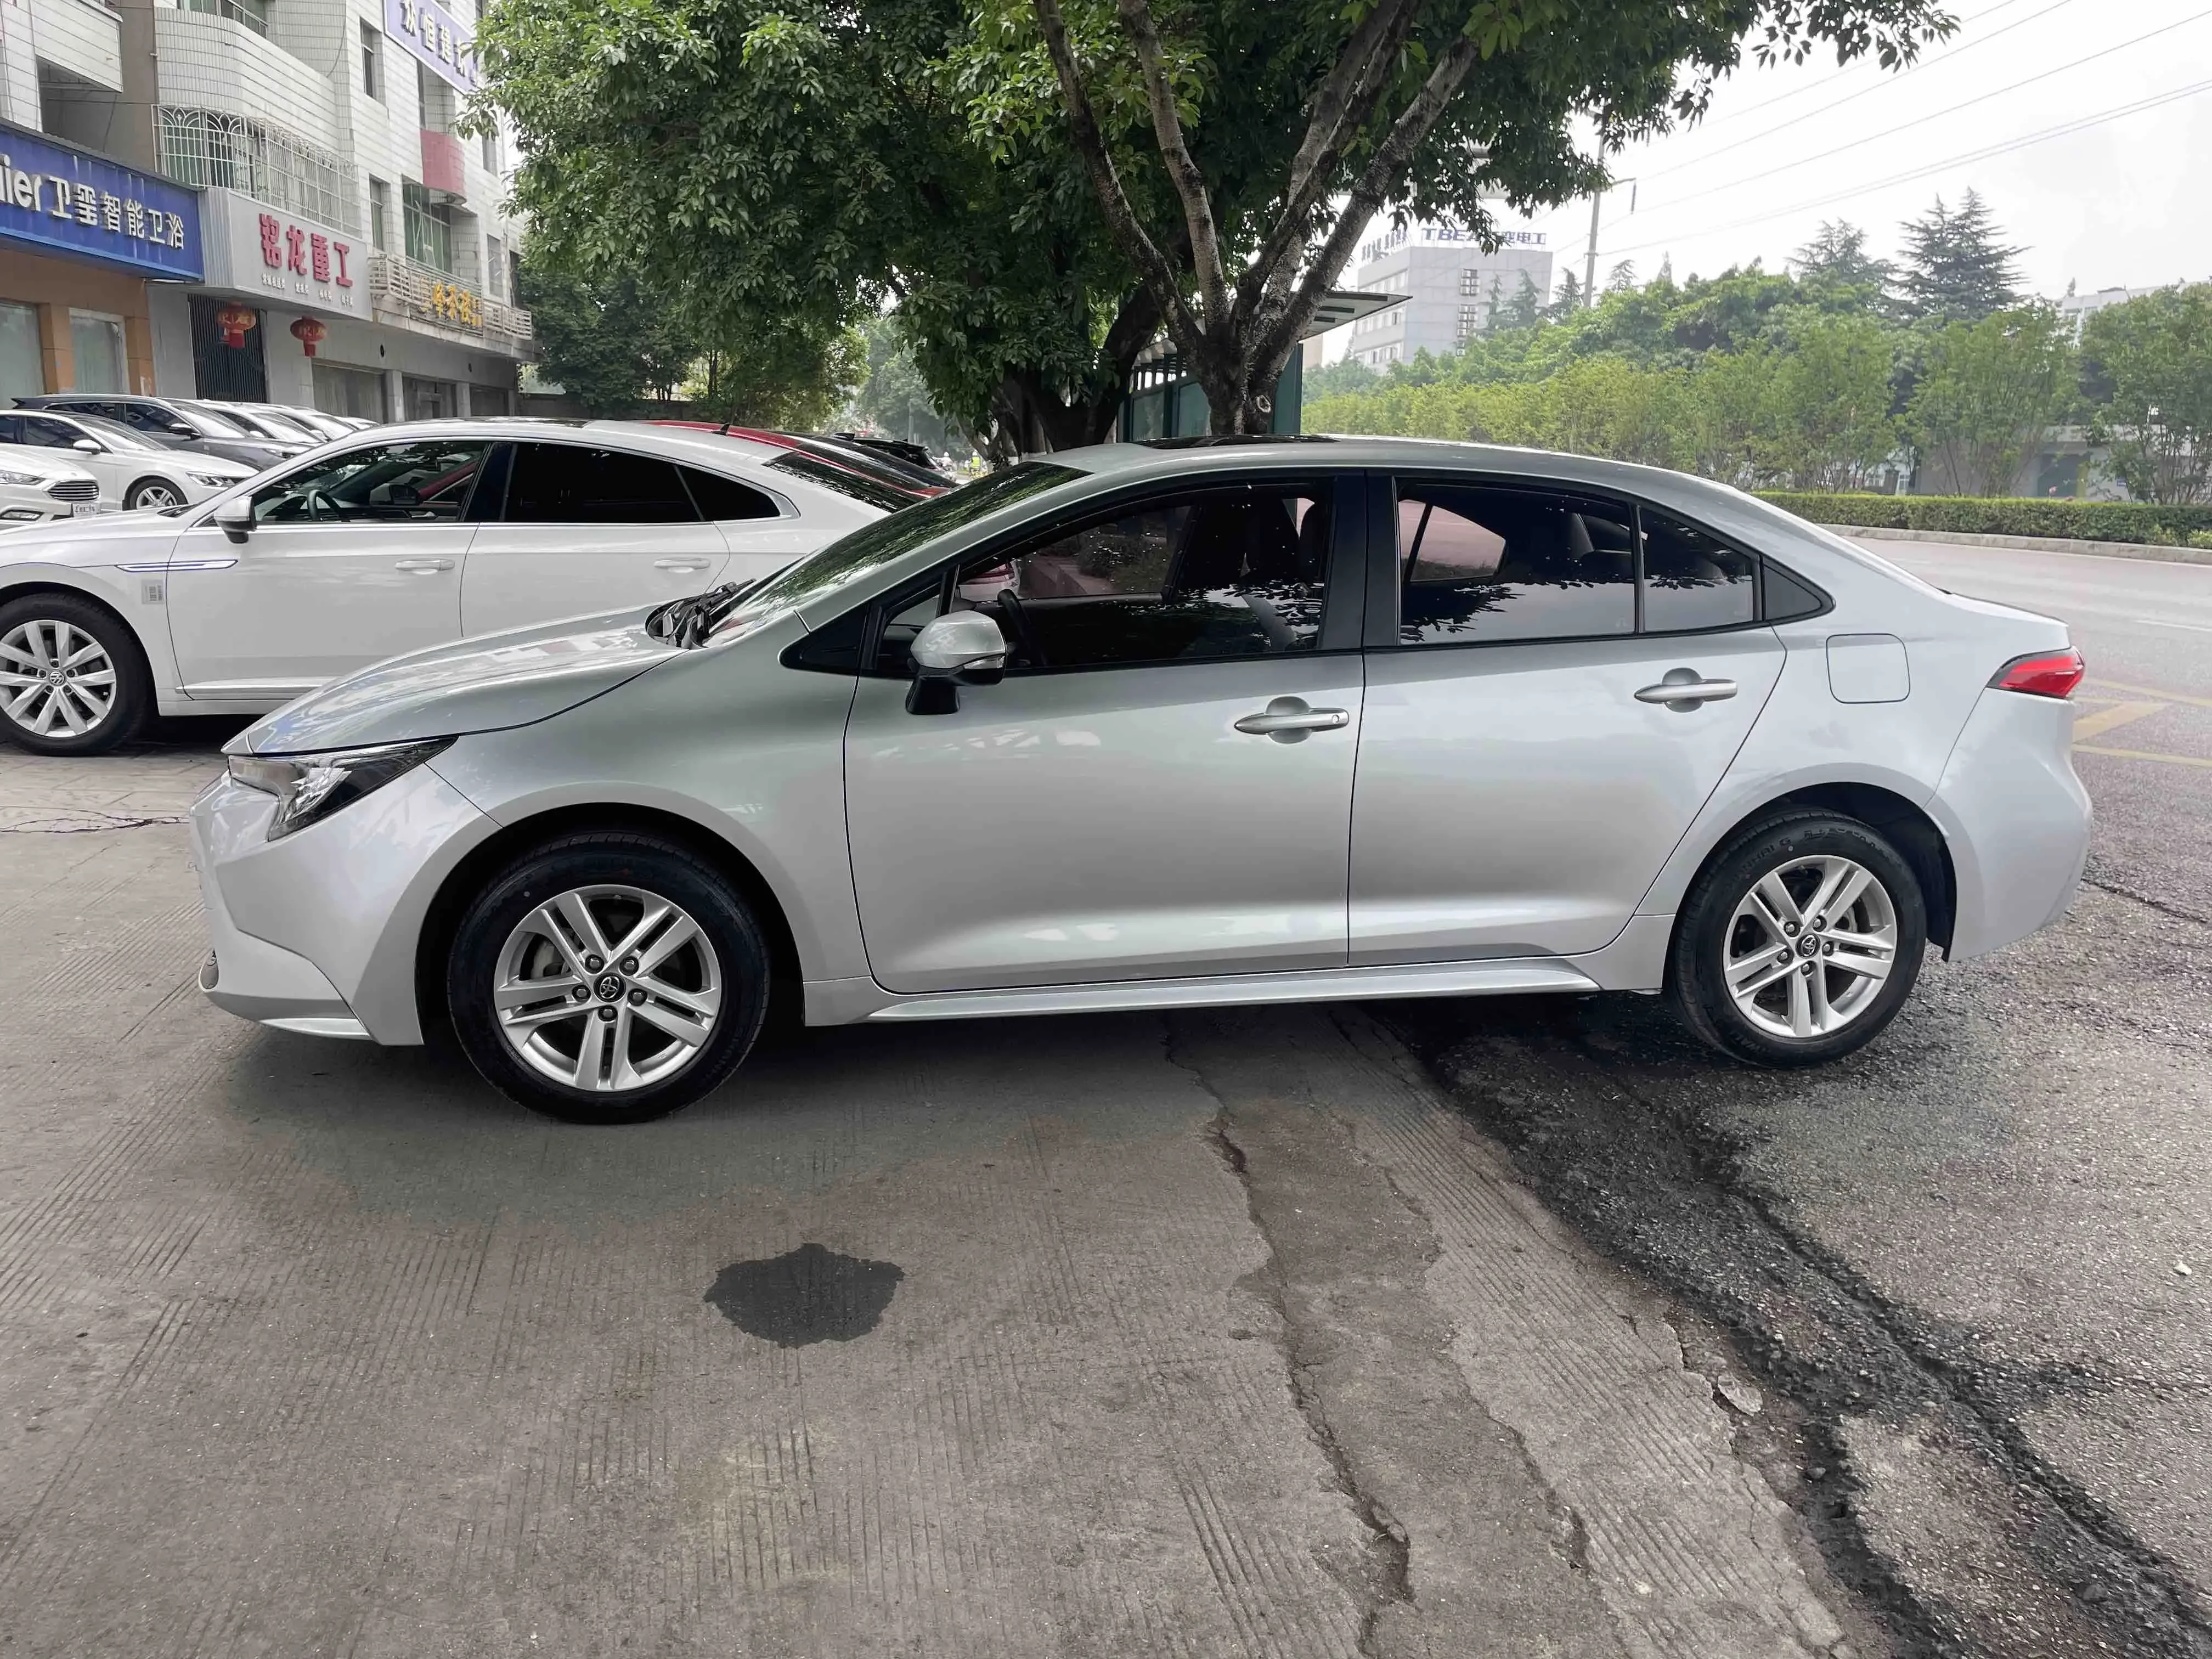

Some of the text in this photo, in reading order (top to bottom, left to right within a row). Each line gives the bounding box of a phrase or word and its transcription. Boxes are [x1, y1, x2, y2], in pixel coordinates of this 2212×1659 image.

[0, 154, 184, 250] ier 卫玺智能卫浴
[1489, 231, 1547, 245] 变电工
[259, 213, 353, 287] 铭龙重工
